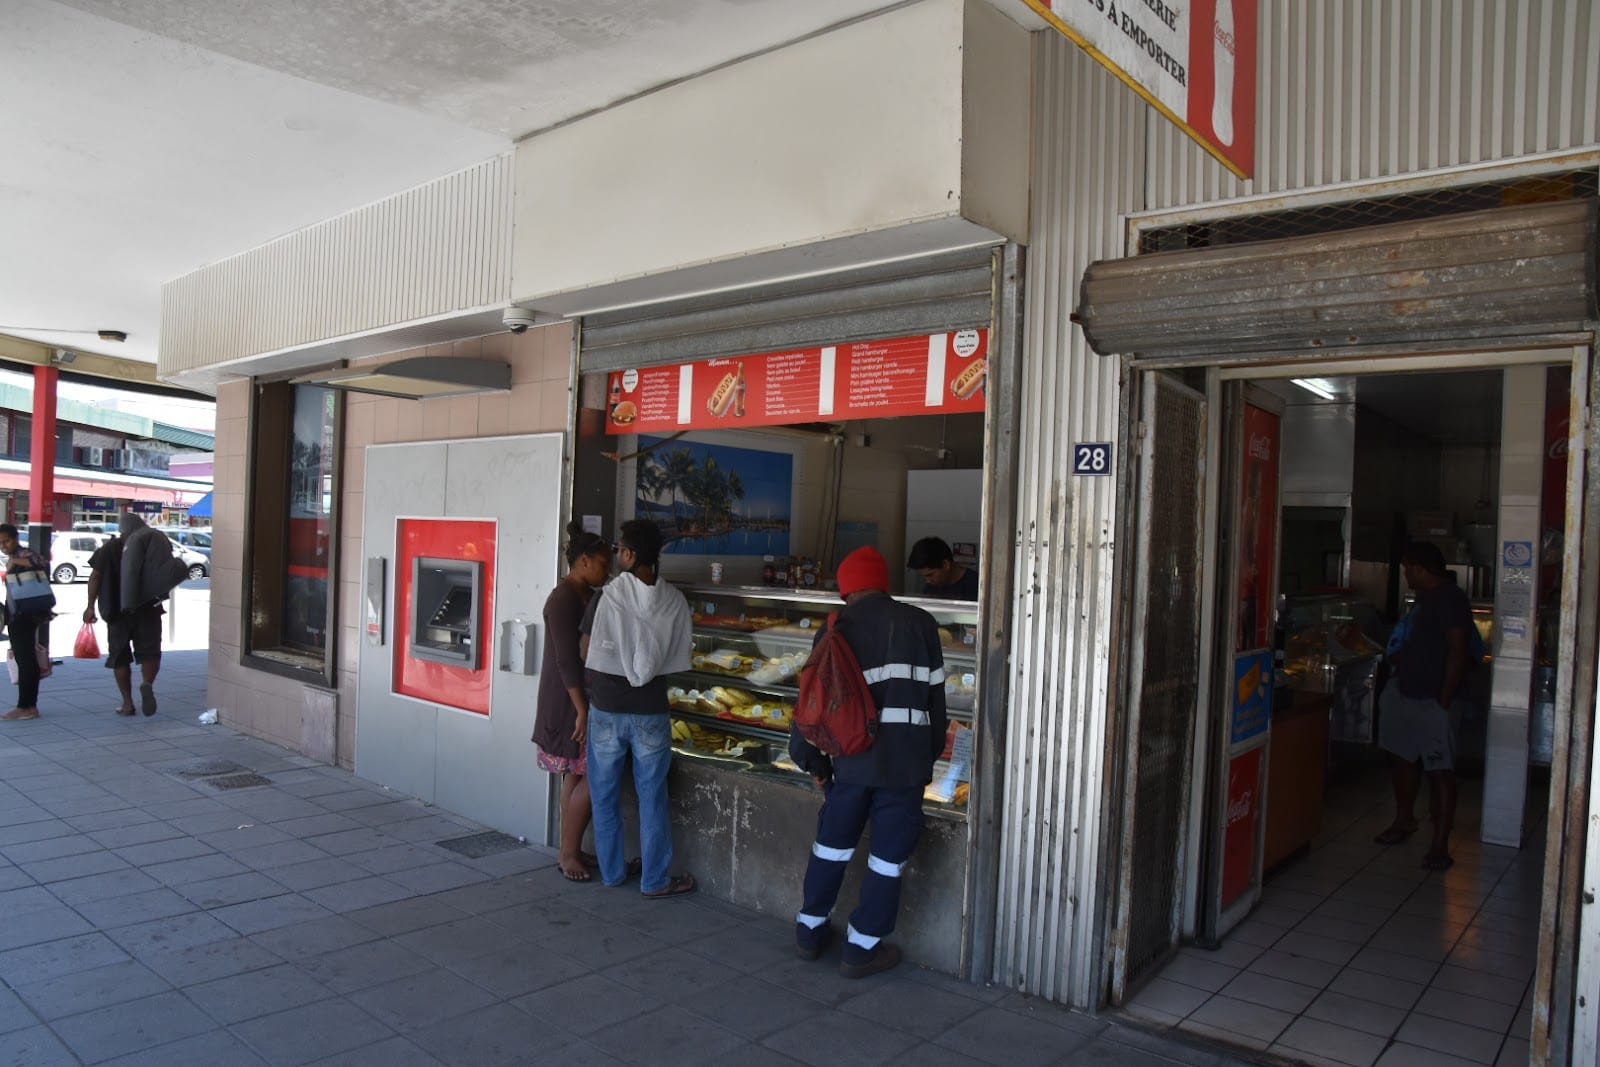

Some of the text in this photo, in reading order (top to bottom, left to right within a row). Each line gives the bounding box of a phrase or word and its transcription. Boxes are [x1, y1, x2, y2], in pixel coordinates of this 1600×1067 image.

[1107, 1, 1119, 27] A
[1121, 11, 1187, 87] EMPORTER
[1078, 447, 1105, 471] 28
